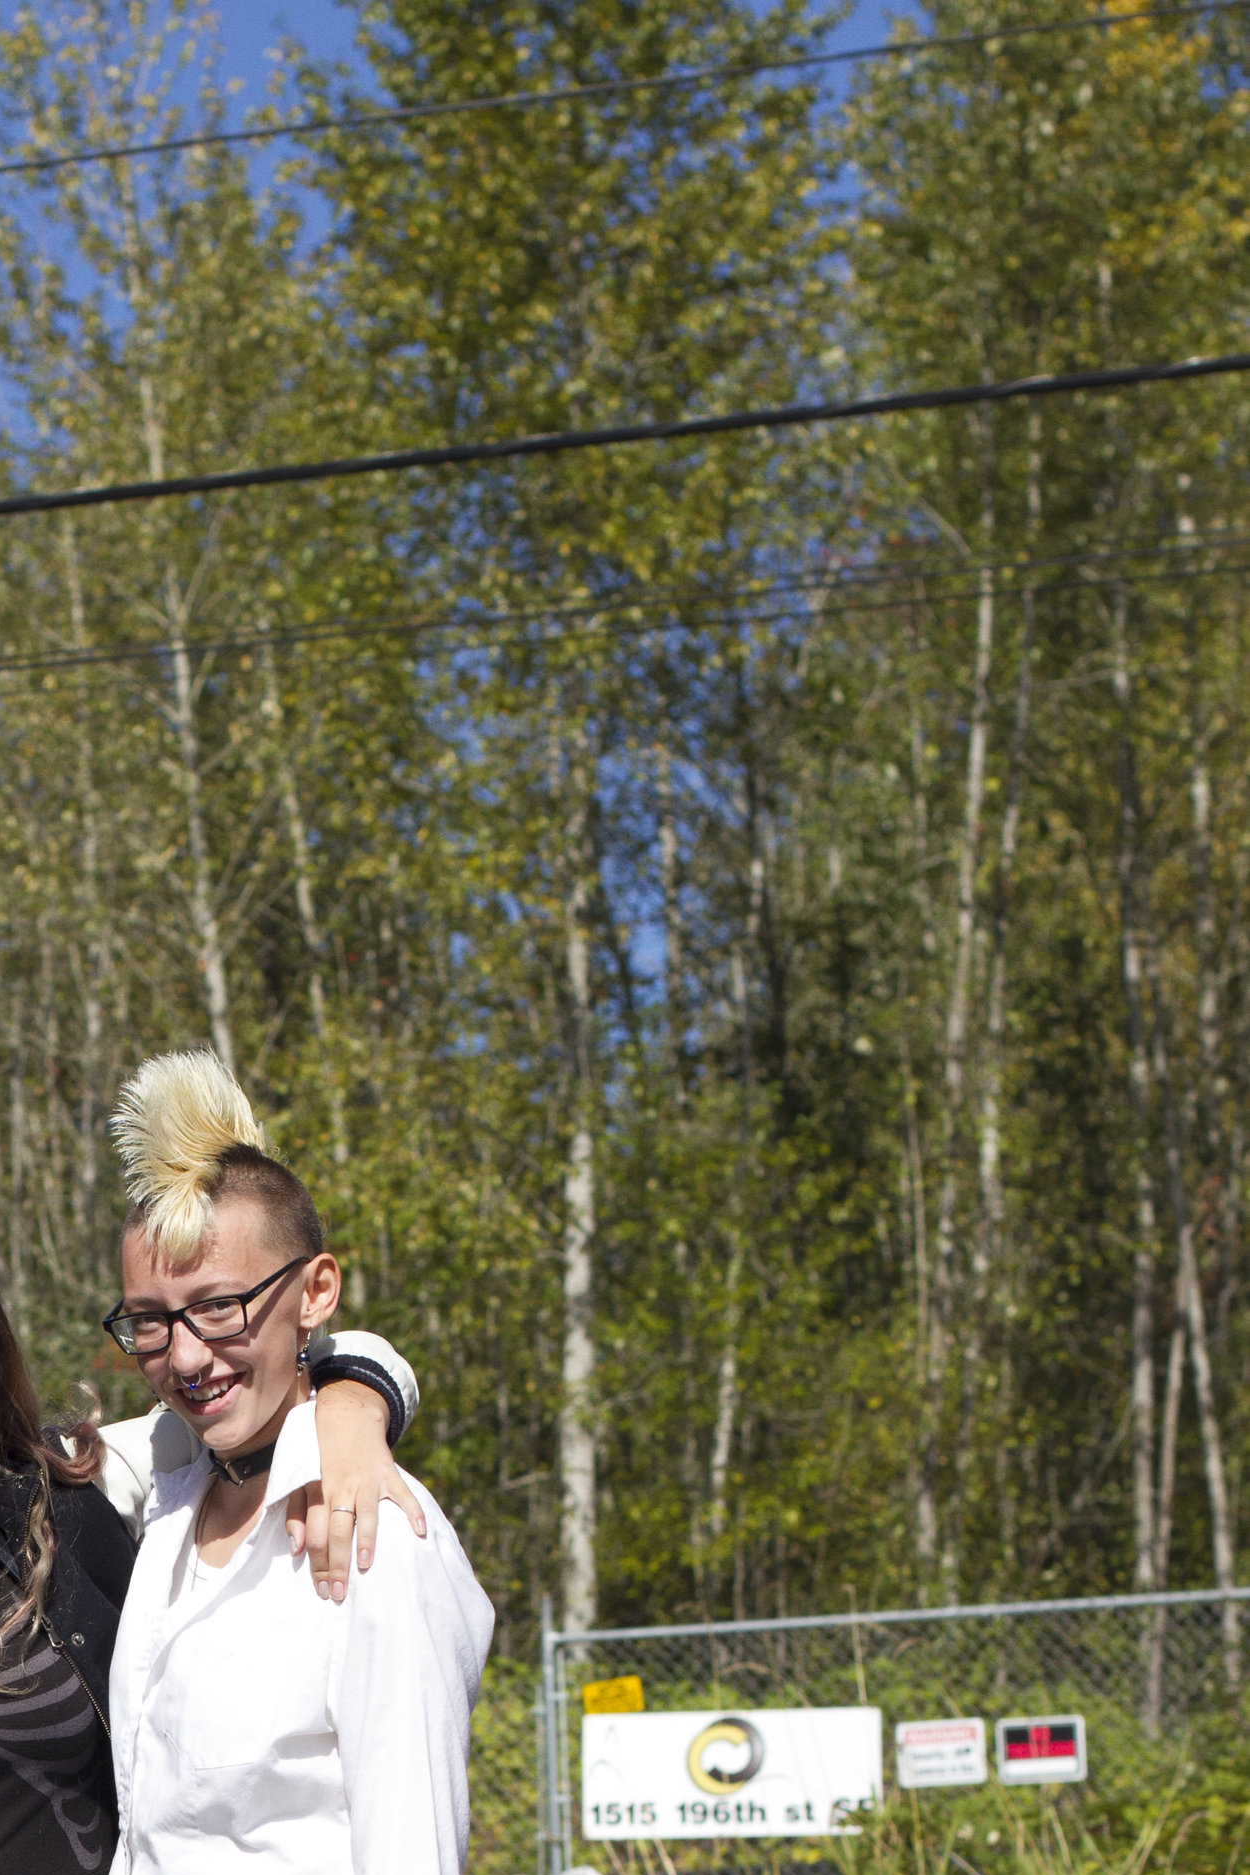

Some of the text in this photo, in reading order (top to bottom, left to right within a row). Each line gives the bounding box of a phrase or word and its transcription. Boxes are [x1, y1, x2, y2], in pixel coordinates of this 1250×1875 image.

[592, 1803, 656, 1825] 1515
[678, 1801, 767, 1824] 196th
[786, 1801, 814, 1822] st
